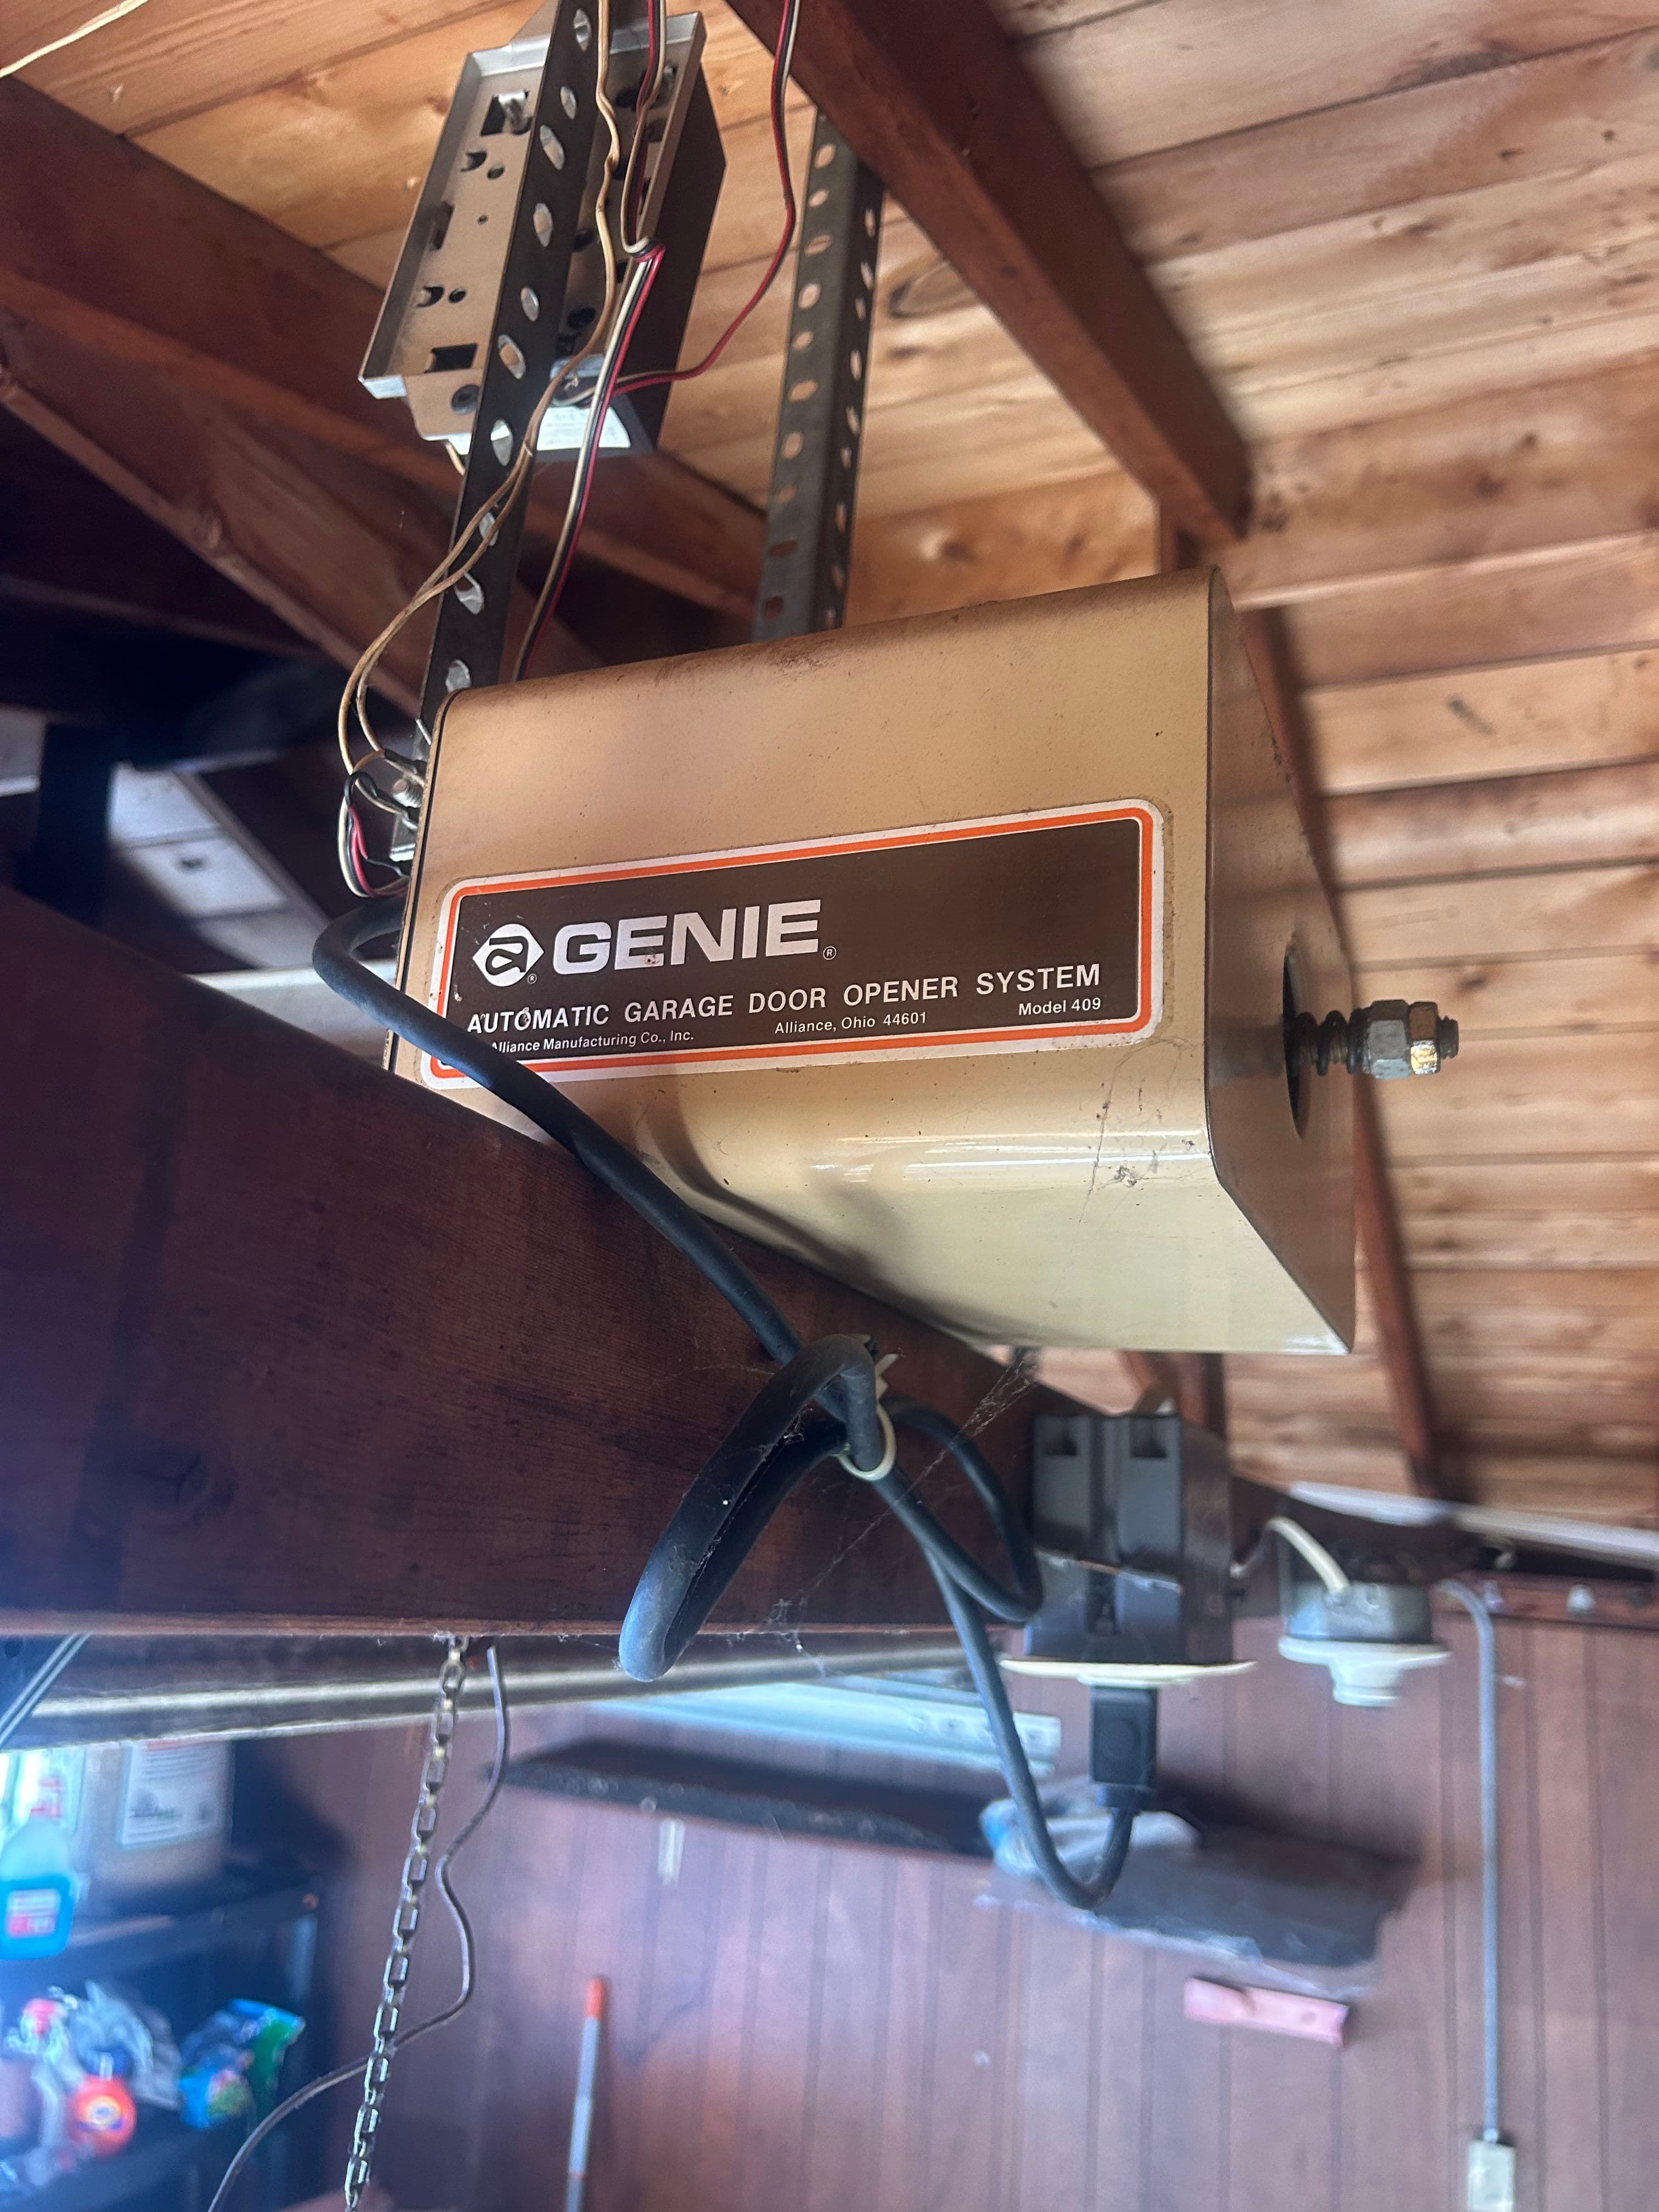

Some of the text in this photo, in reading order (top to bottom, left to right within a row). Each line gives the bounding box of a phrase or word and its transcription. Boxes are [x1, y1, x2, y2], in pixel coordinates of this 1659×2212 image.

[554, 899, 821, 975] GENIE
[467, 964, 1100, 1034] AUTOMATIC GARAGE DOOR OPENER SYSTEM
[1019, 997, 1102, 1015] Model 409
[775, 1012, 927, 1034] Alliance, Ohio 44601
[544, 1033, 636, 1051] Manufacturing
[641, 1031, 666, 1045] Co.,
[670, 1030, 694, 1042] Inc.
